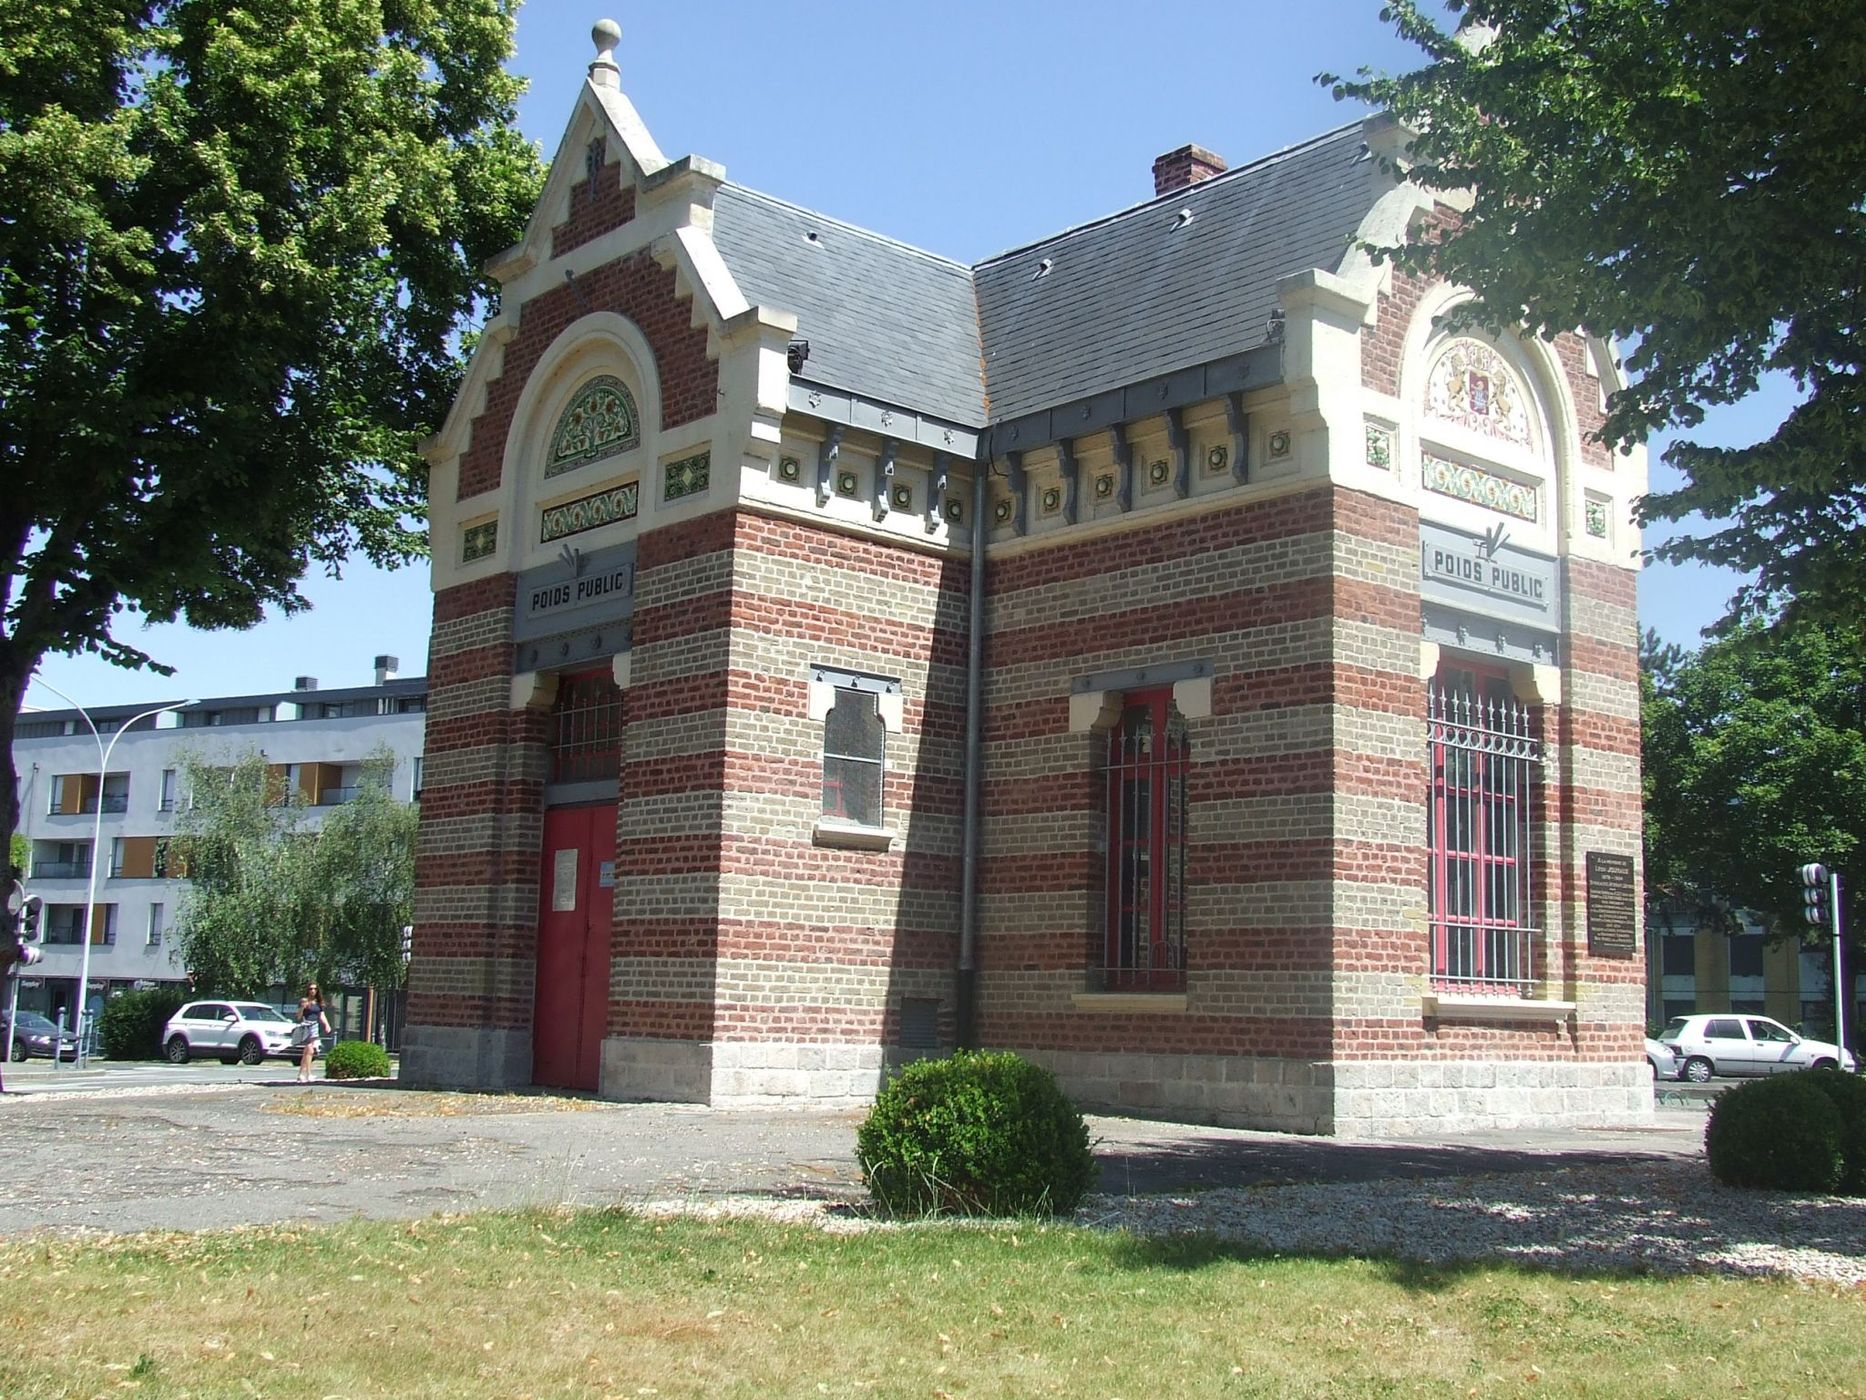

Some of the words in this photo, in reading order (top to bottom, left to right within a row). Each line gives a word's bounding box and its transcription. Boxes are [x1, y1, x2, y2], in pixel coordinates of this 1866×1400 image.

[532, 585, 570, 610] POIDS
[578, 573, 623, 600] PUBLIC
[1435, 551, 1482, 582] POIDS
[1492, 567, 1542, 598] PUBLIC
